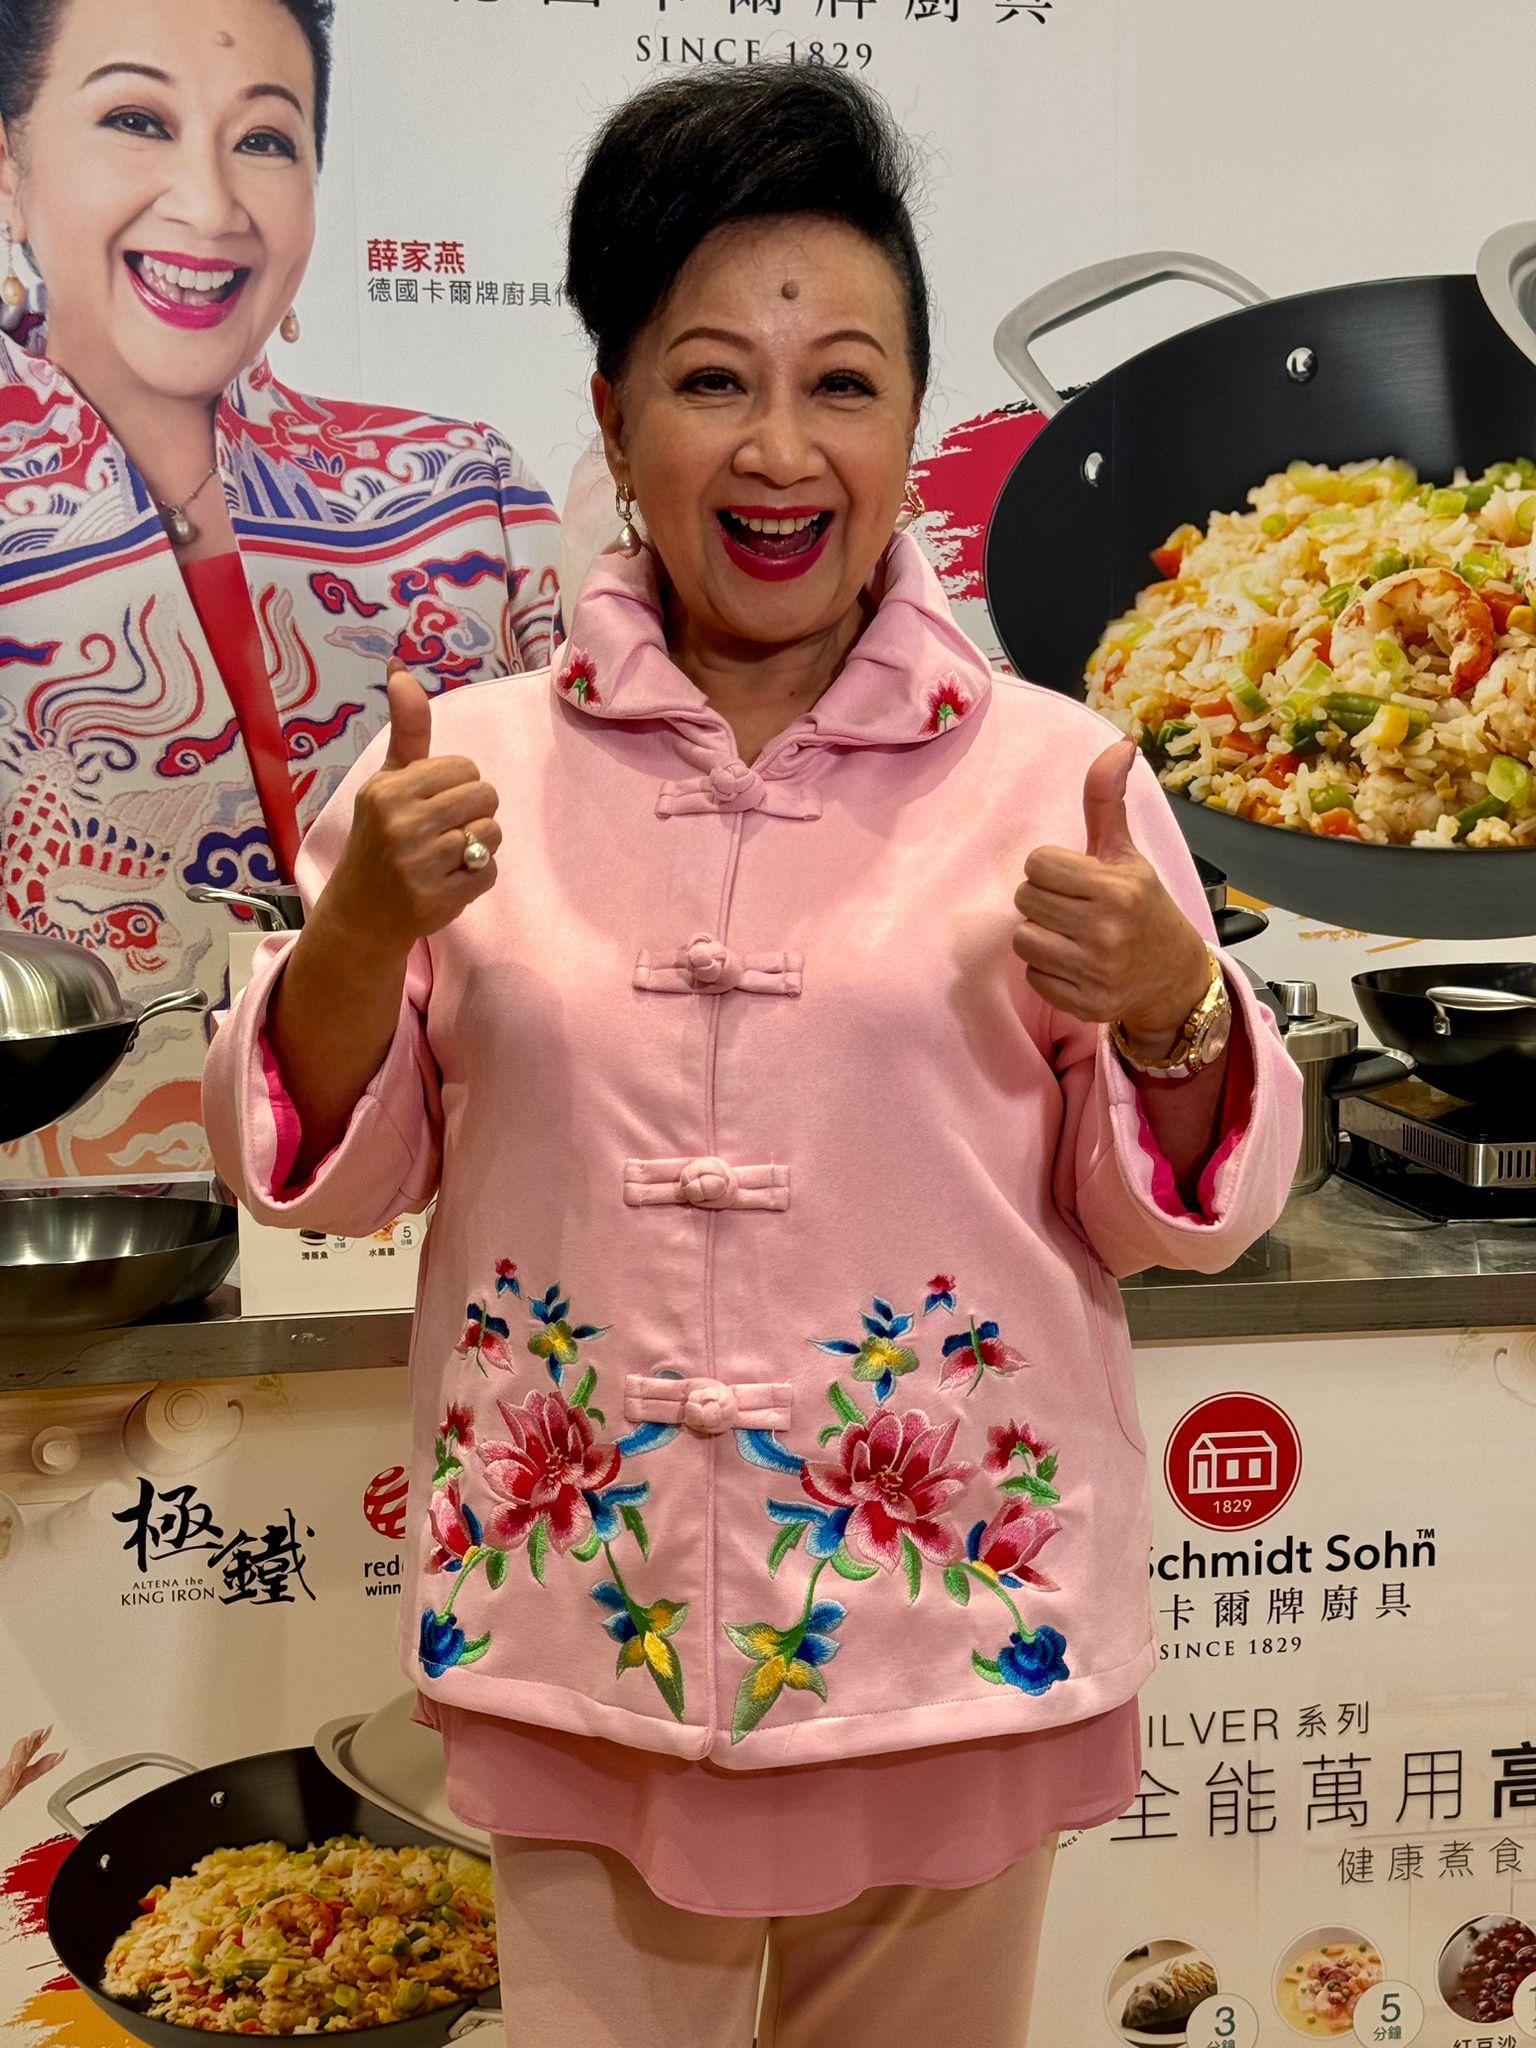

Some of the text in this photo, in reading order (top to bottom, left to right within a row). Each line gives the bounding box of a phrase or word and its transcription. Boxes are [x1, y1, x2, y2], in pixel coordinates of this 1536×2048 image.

[636, 35, 873, 69] SINCE 1829
[367, 238, 466, 274] 薛家燕
[403, 1226, 412, 1238] 5
[1213, 1498, 1252, 1514] 1829
[364, 1554, 404, 1577] red
[1148, 1535, 1313, 1581] chmidt
[121, 1587, 215, 1606] KING IRON
[132, 1577, 203, 1590] ALTENA the
[1159, 1636, 1301, 1660] SINCE 1829
[1297, 1701, 1369, 1738] 系列
[1110, 1741, 1536, 1841] 全能萬用高
[1337, 1837, 1525, 1886] 健康煮食
[1214, 2006, 1235, 2037] 3
[1381, 1993, 1401, 2023] 5
[1373, 2026, 1402, 2041] 分鐘
